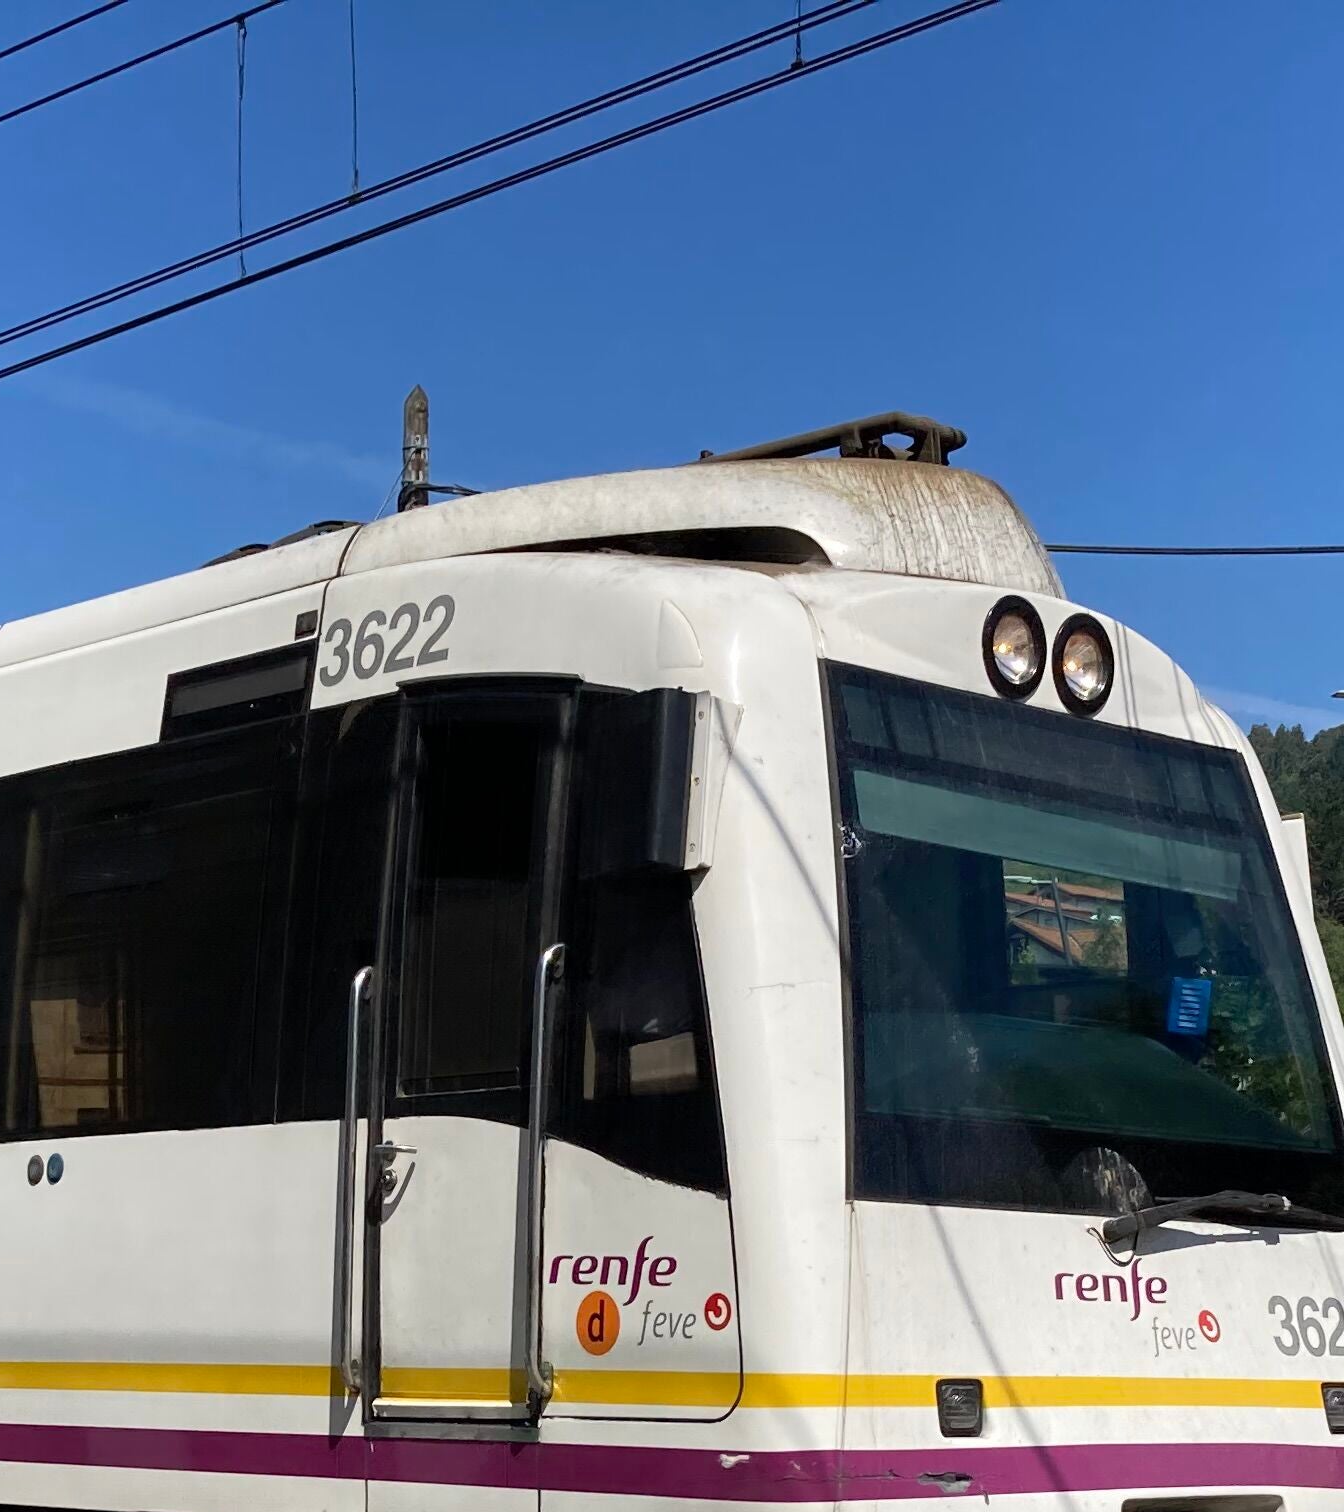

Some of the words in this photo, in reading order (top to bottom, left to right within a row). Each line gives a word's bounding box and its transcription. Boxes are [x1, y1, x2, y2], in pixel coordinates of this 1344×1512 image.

[319, 594, 455, 687] 3622
[548, 1236, 678, 1307] renfe
[1054, 1257, 1168, 1322] renfe
[637, 1300, 697, 1346] feve
[1152, 1317, 1198, 1358] feve
